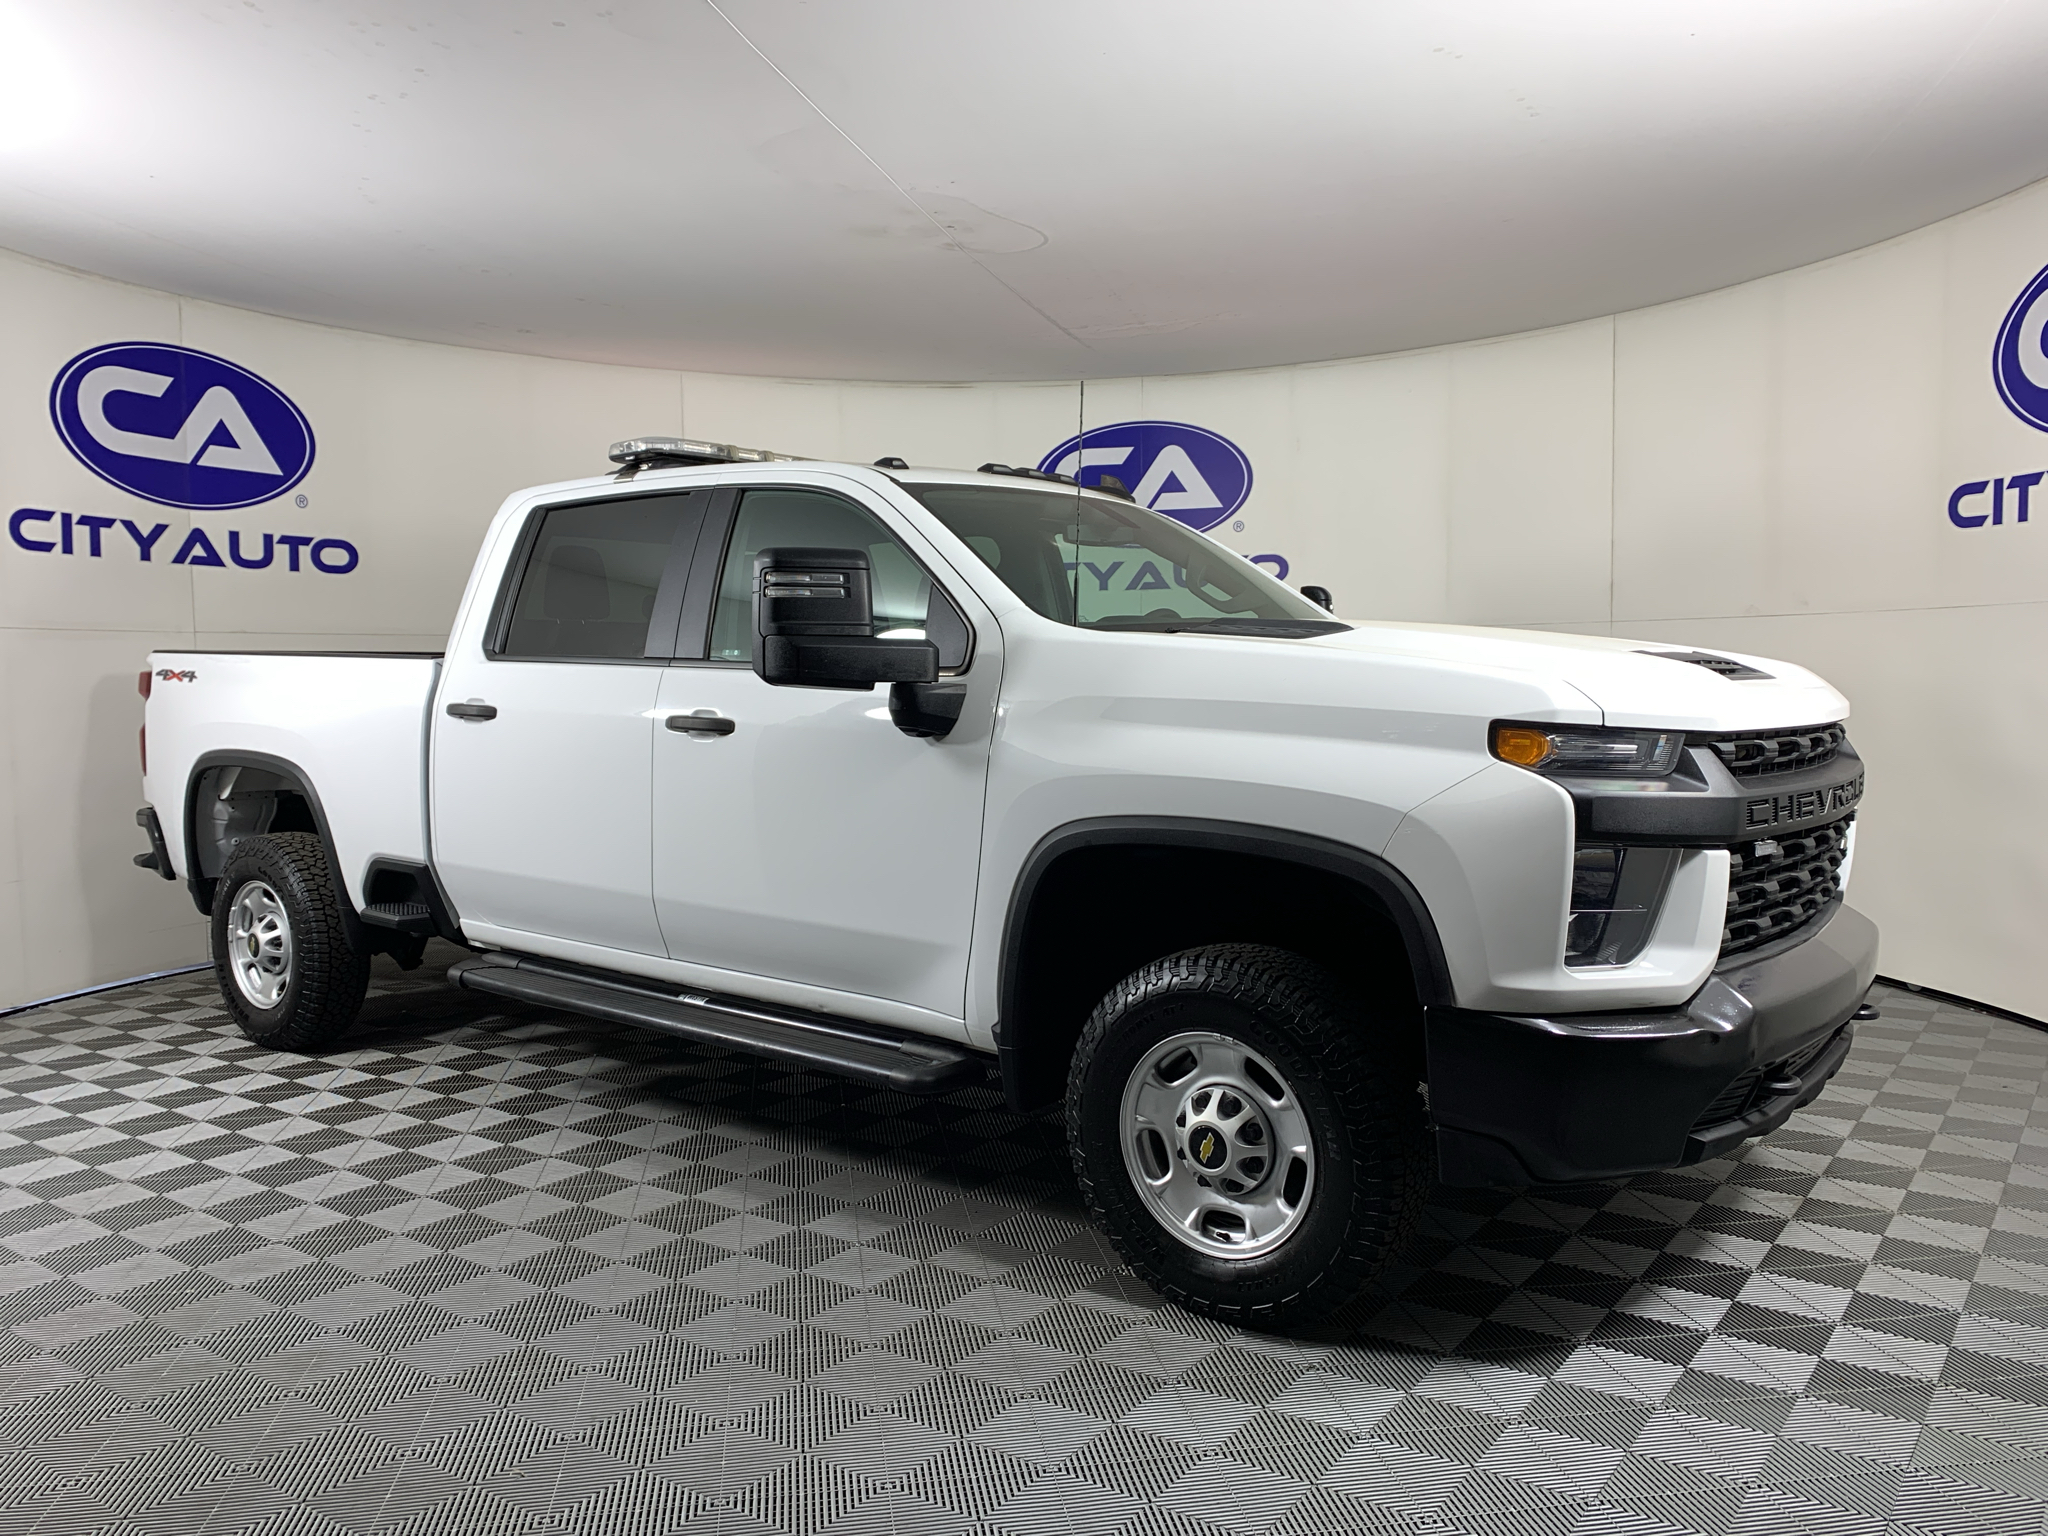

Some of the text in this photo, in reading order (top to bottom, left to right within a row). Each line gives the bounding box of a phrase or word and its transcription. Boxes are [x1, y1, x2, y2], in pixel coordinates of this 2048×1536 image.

[76, 365, 284, 476] CA
[1948, 470, 2048, 528] CIT
[9, 507, 359, 574] CITY AUTO
